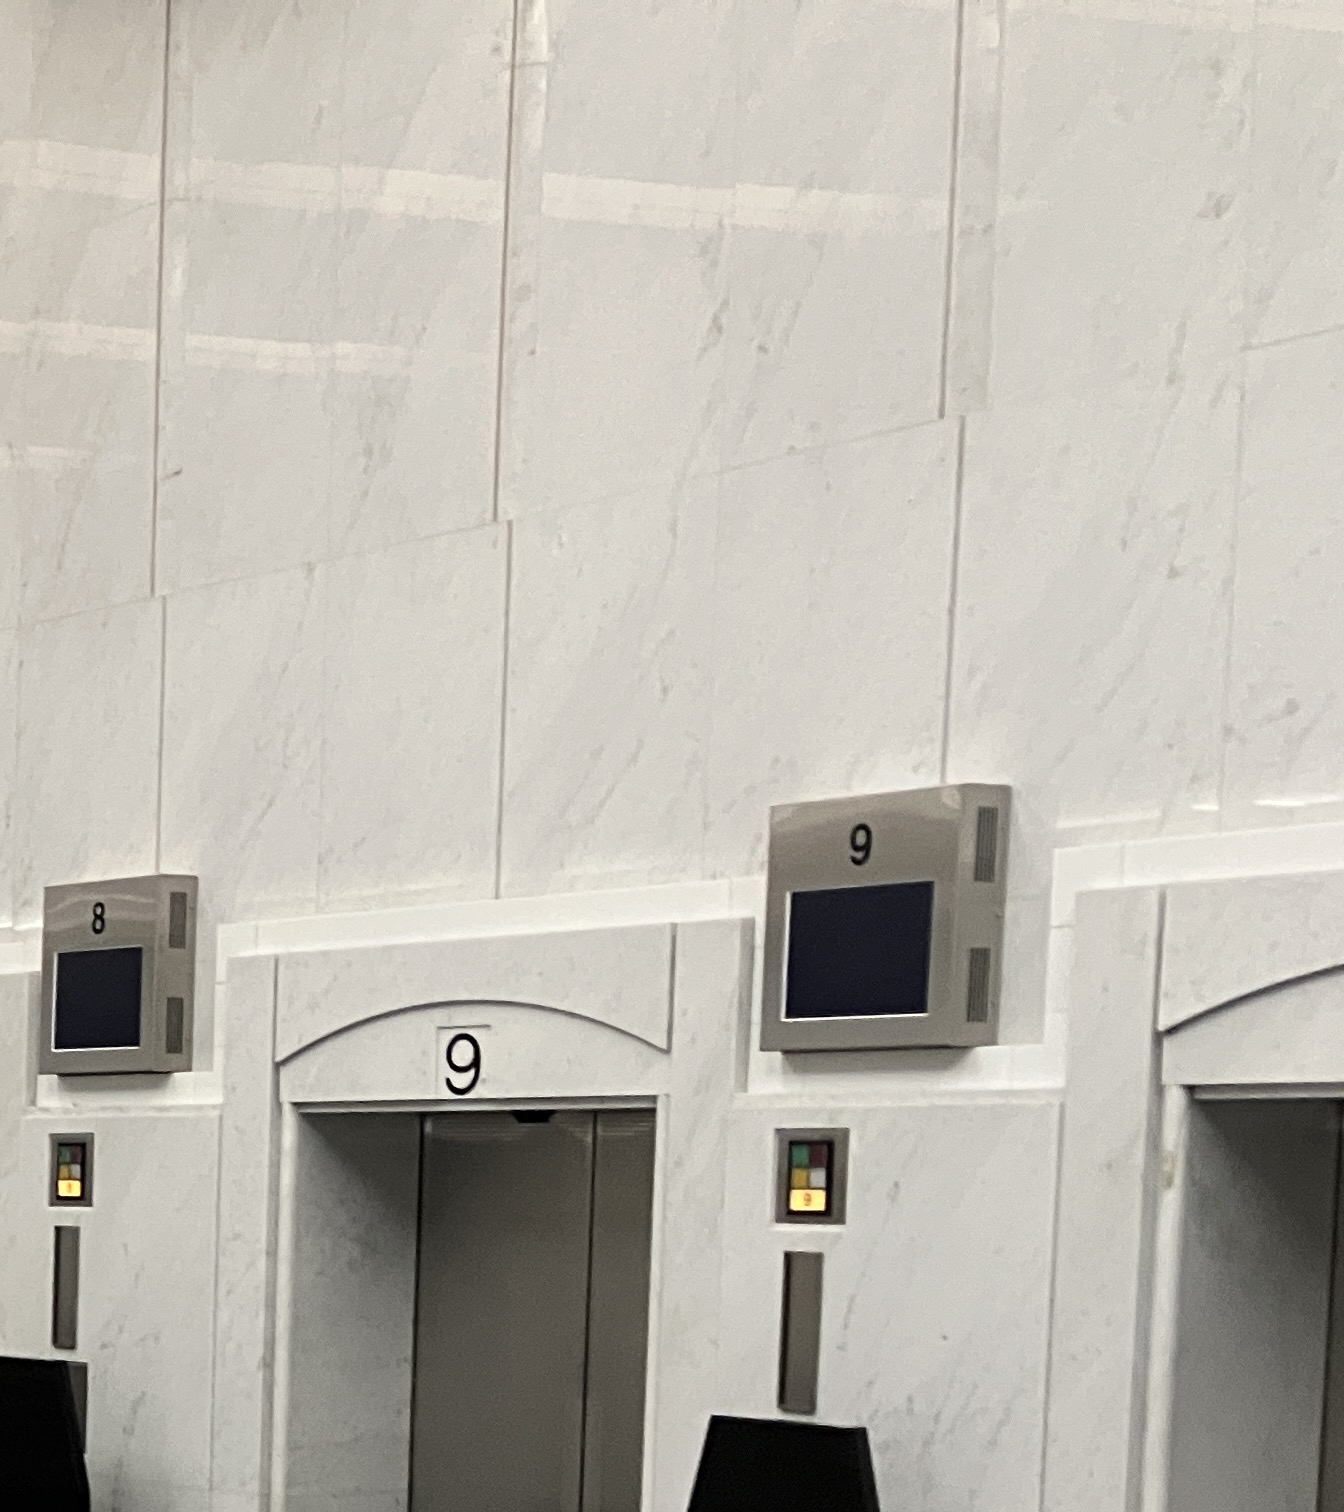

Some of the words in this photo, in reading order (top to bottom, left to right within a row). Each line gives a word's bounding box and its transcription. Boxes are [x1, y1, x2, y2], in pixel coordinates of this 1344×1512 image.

[849, 823, 872, 866] 9
[91, 902, 105, 935] 8
[445, 1033, 481, 1095] 9
